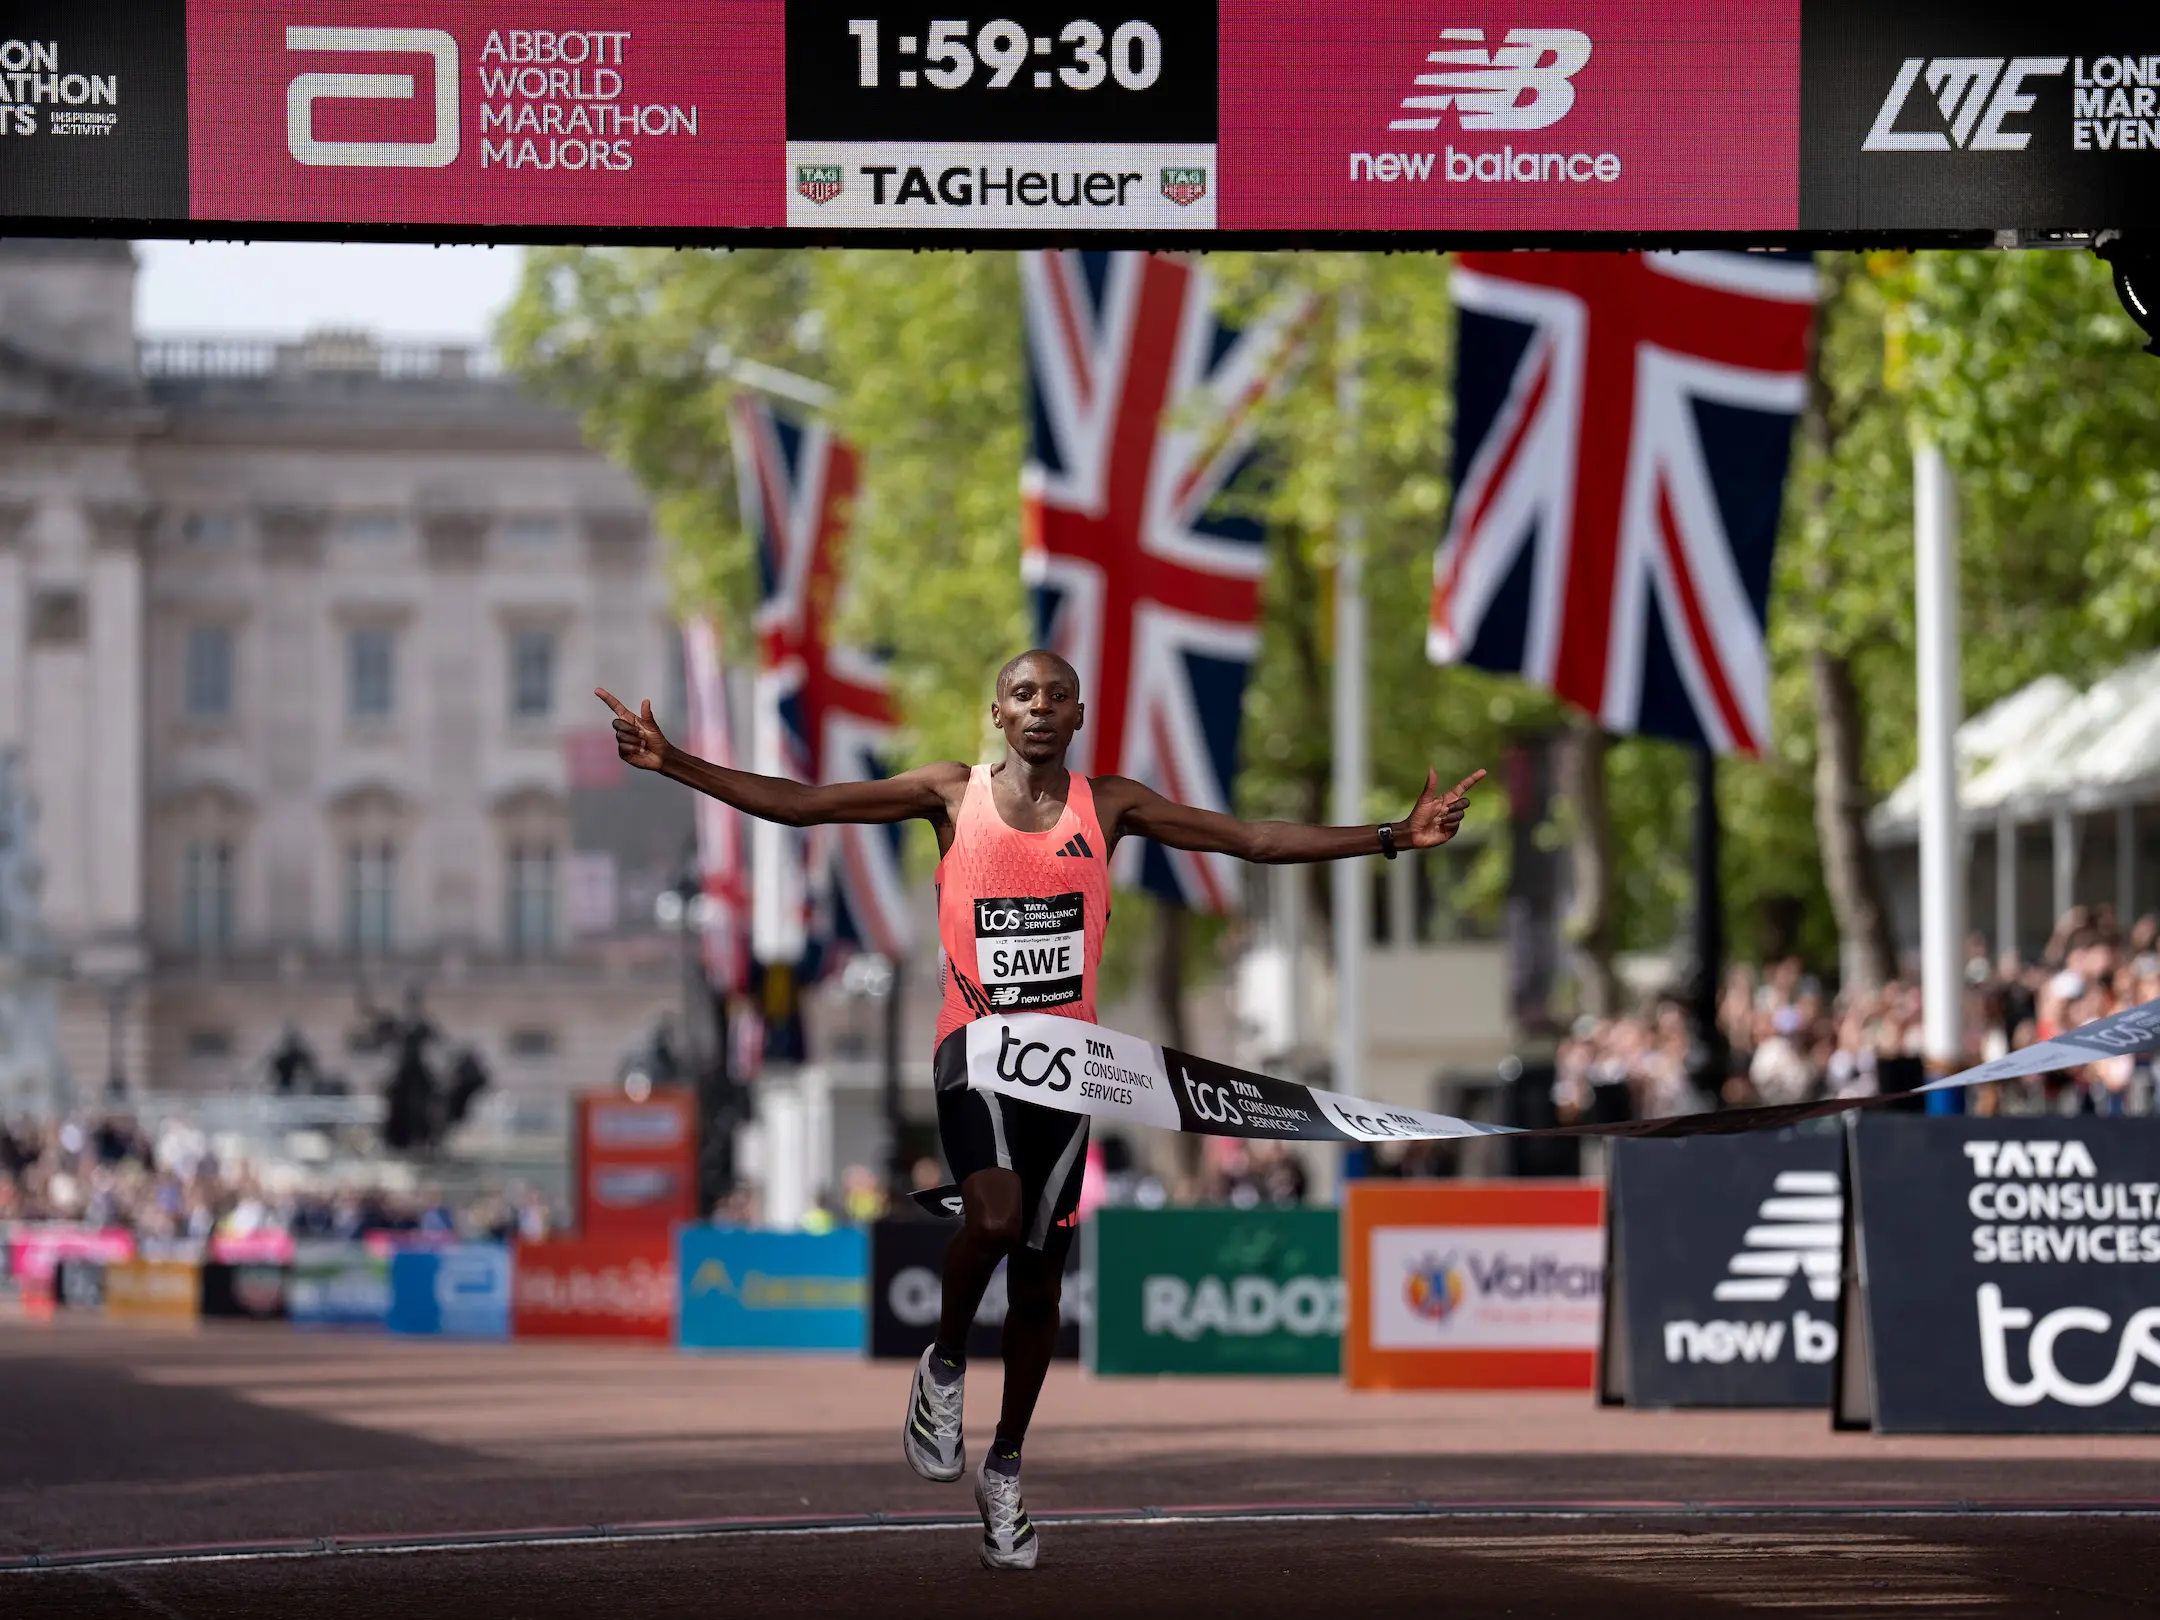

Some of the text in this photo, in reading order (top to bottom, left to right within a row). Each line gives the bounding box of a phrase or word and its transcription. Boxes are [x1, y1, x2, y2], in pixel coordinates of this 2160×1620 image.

[479, 30, 632, 64] ABBOTT
[848, 19, 1162, 91] 1:59:30
[479, 67, 624, 100] WORLD
[50, 111, 117, 124] INSPIRING
[50, 123, 112, 135] ACTIVITY
[479, 102, 698, 135] MARATHON
[479, 137, 634, 170] MAJORS
[1349, 146, 1621, 183] new balance
[981, 904, 1021, 931] tcs
[1024, 908, 1077, 920] CONSULTANCY
[1024, 920, 1061, 929] SERVICES
[993, 945, 1071, 978] SAWE
[1021, 989, 1074, 1004] new balance
[996, 1025, 1076, 1092] tcs
[1086, 1038, 1115, 1061] TATA
[1084, 1060, 1154, 1090] CONSULTANCY
[1229, 1079, 1264, 1100] TATA
[1080, 1081, 1133, 1105] SERVICES
[1181, 1066, 1244, 1126] tcs
[1238, 1098, 1312, 1122] CONSULTANCY
[1247, 1115, 1300, 1132] SERVICES
[1385, 1112, 1422, 1126] TATA
[1964, 1140, 2098, 1178] TATA
[1968, 1182, 2160, 1220] CONSULT
[1972, 1224, 2160, 1264] SERVICES
[1664, 1319, 1787, 1364] new
